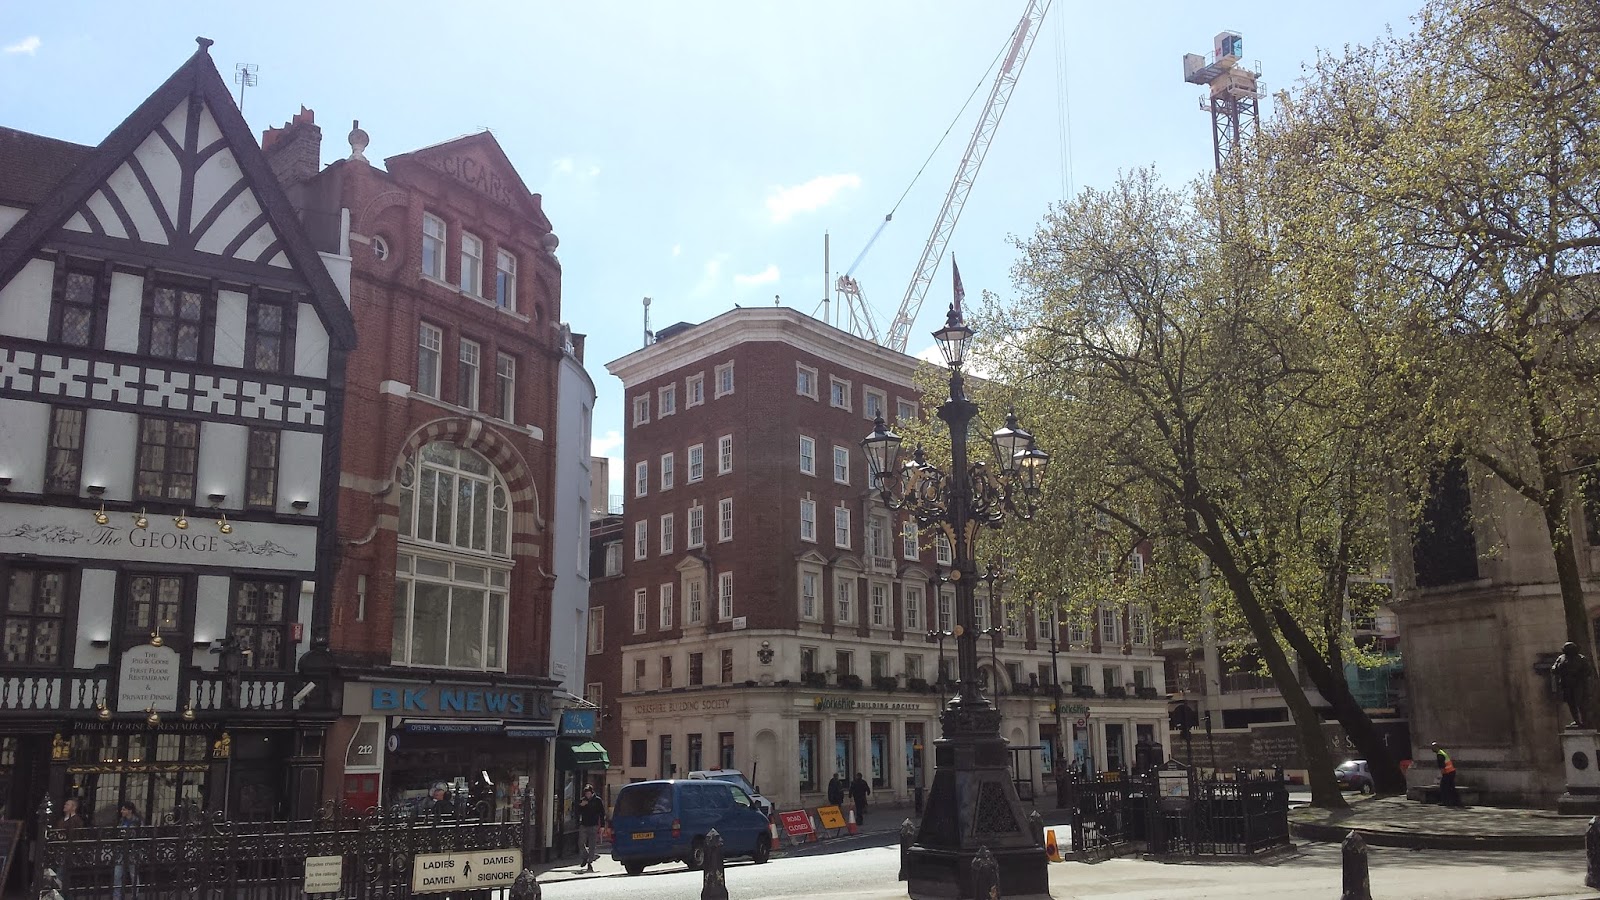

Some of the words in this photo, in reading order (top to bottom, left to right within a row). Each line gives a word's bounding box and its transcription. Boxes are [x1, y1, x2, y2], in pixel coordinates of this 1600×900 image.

[87, 525, 122, 546] The
[129, 528, 219, 552] GEORGE
[372, 688, 429, 711] BK
[439, 688, 525, 713] NEWS
[669, 701, 699, 712] BUILDING
[702, 699, 730, 710] SOCIETY
[821, 697, 855, 711] Yorkshire
[892, 702, 920, 710] SOCIETY
[357, 745, 373, 754] 212
[786, 815, 802, 823] ROAD
[788, 823, 808, 832] CLOSED
[423, 859, 455, 870] LADIES
[483, 856, 514, 866] DAMES
[423, 875, 456, 886] DAMEN
[477, 871, 514, 882] SIGNORE
